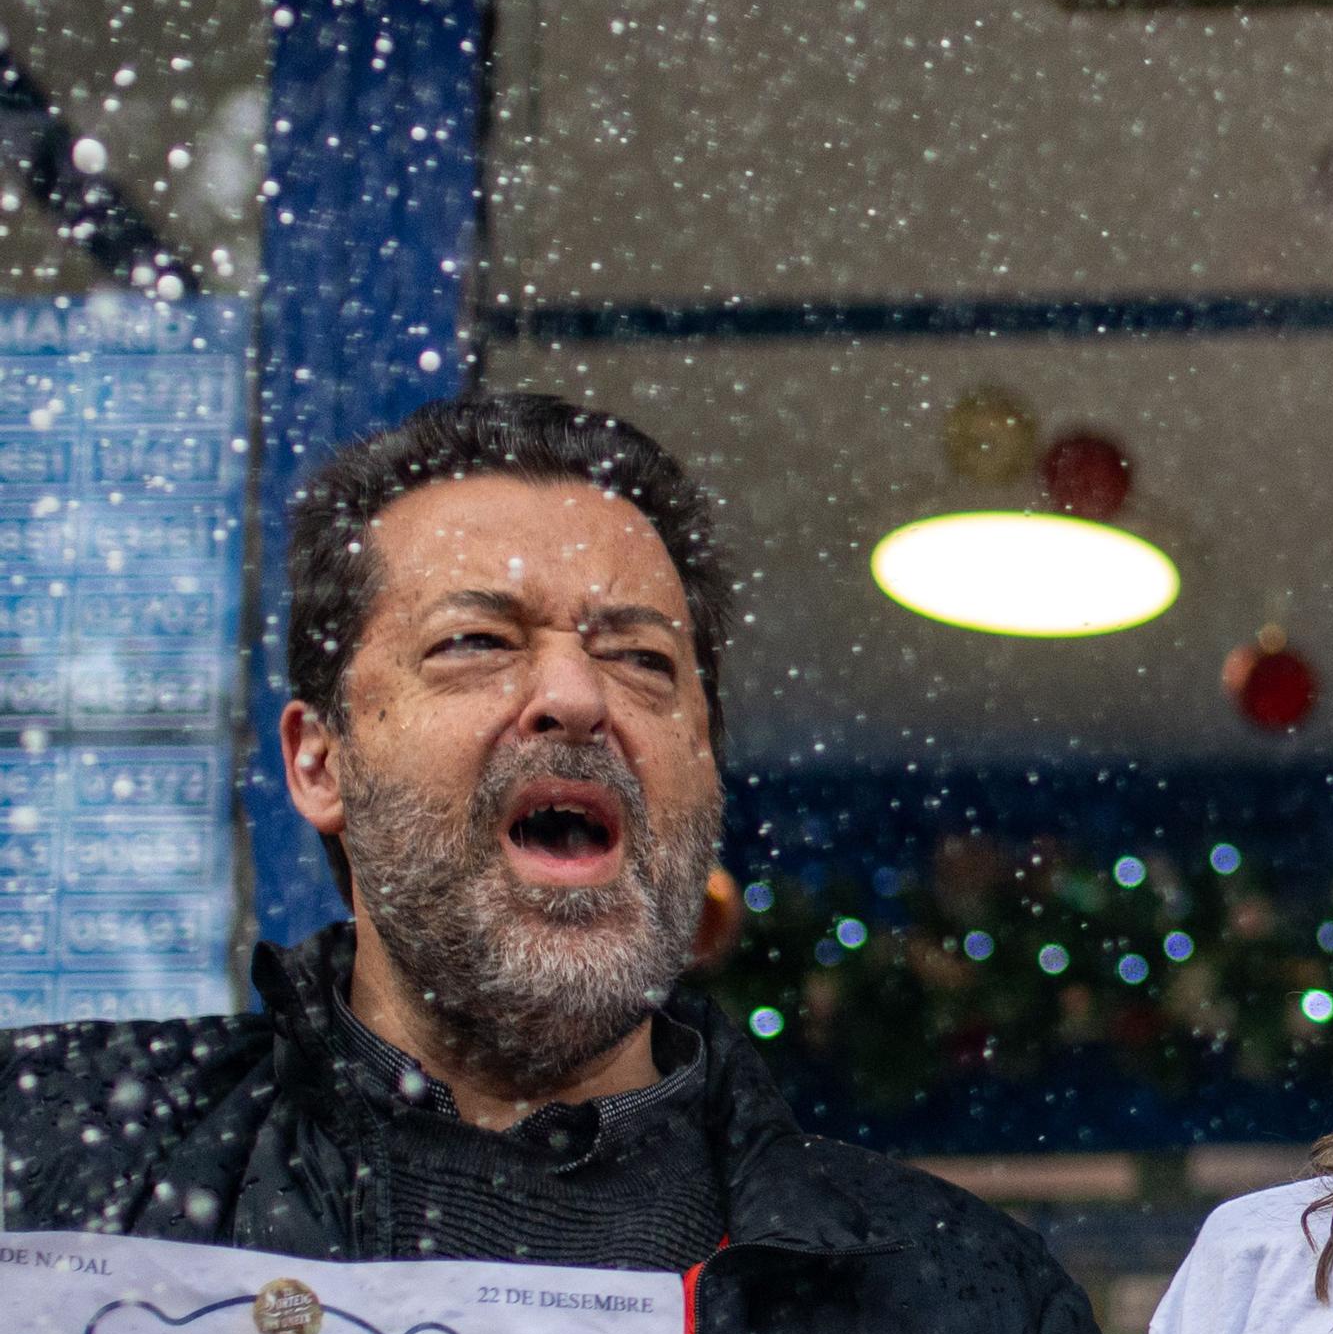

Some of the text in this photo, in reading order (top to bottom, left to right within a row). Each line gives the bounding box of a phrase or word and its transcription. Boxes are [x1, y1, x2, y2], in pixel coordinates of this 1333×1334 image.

[478, 1286, 655, 1314] 22 DE DESEMBRE
